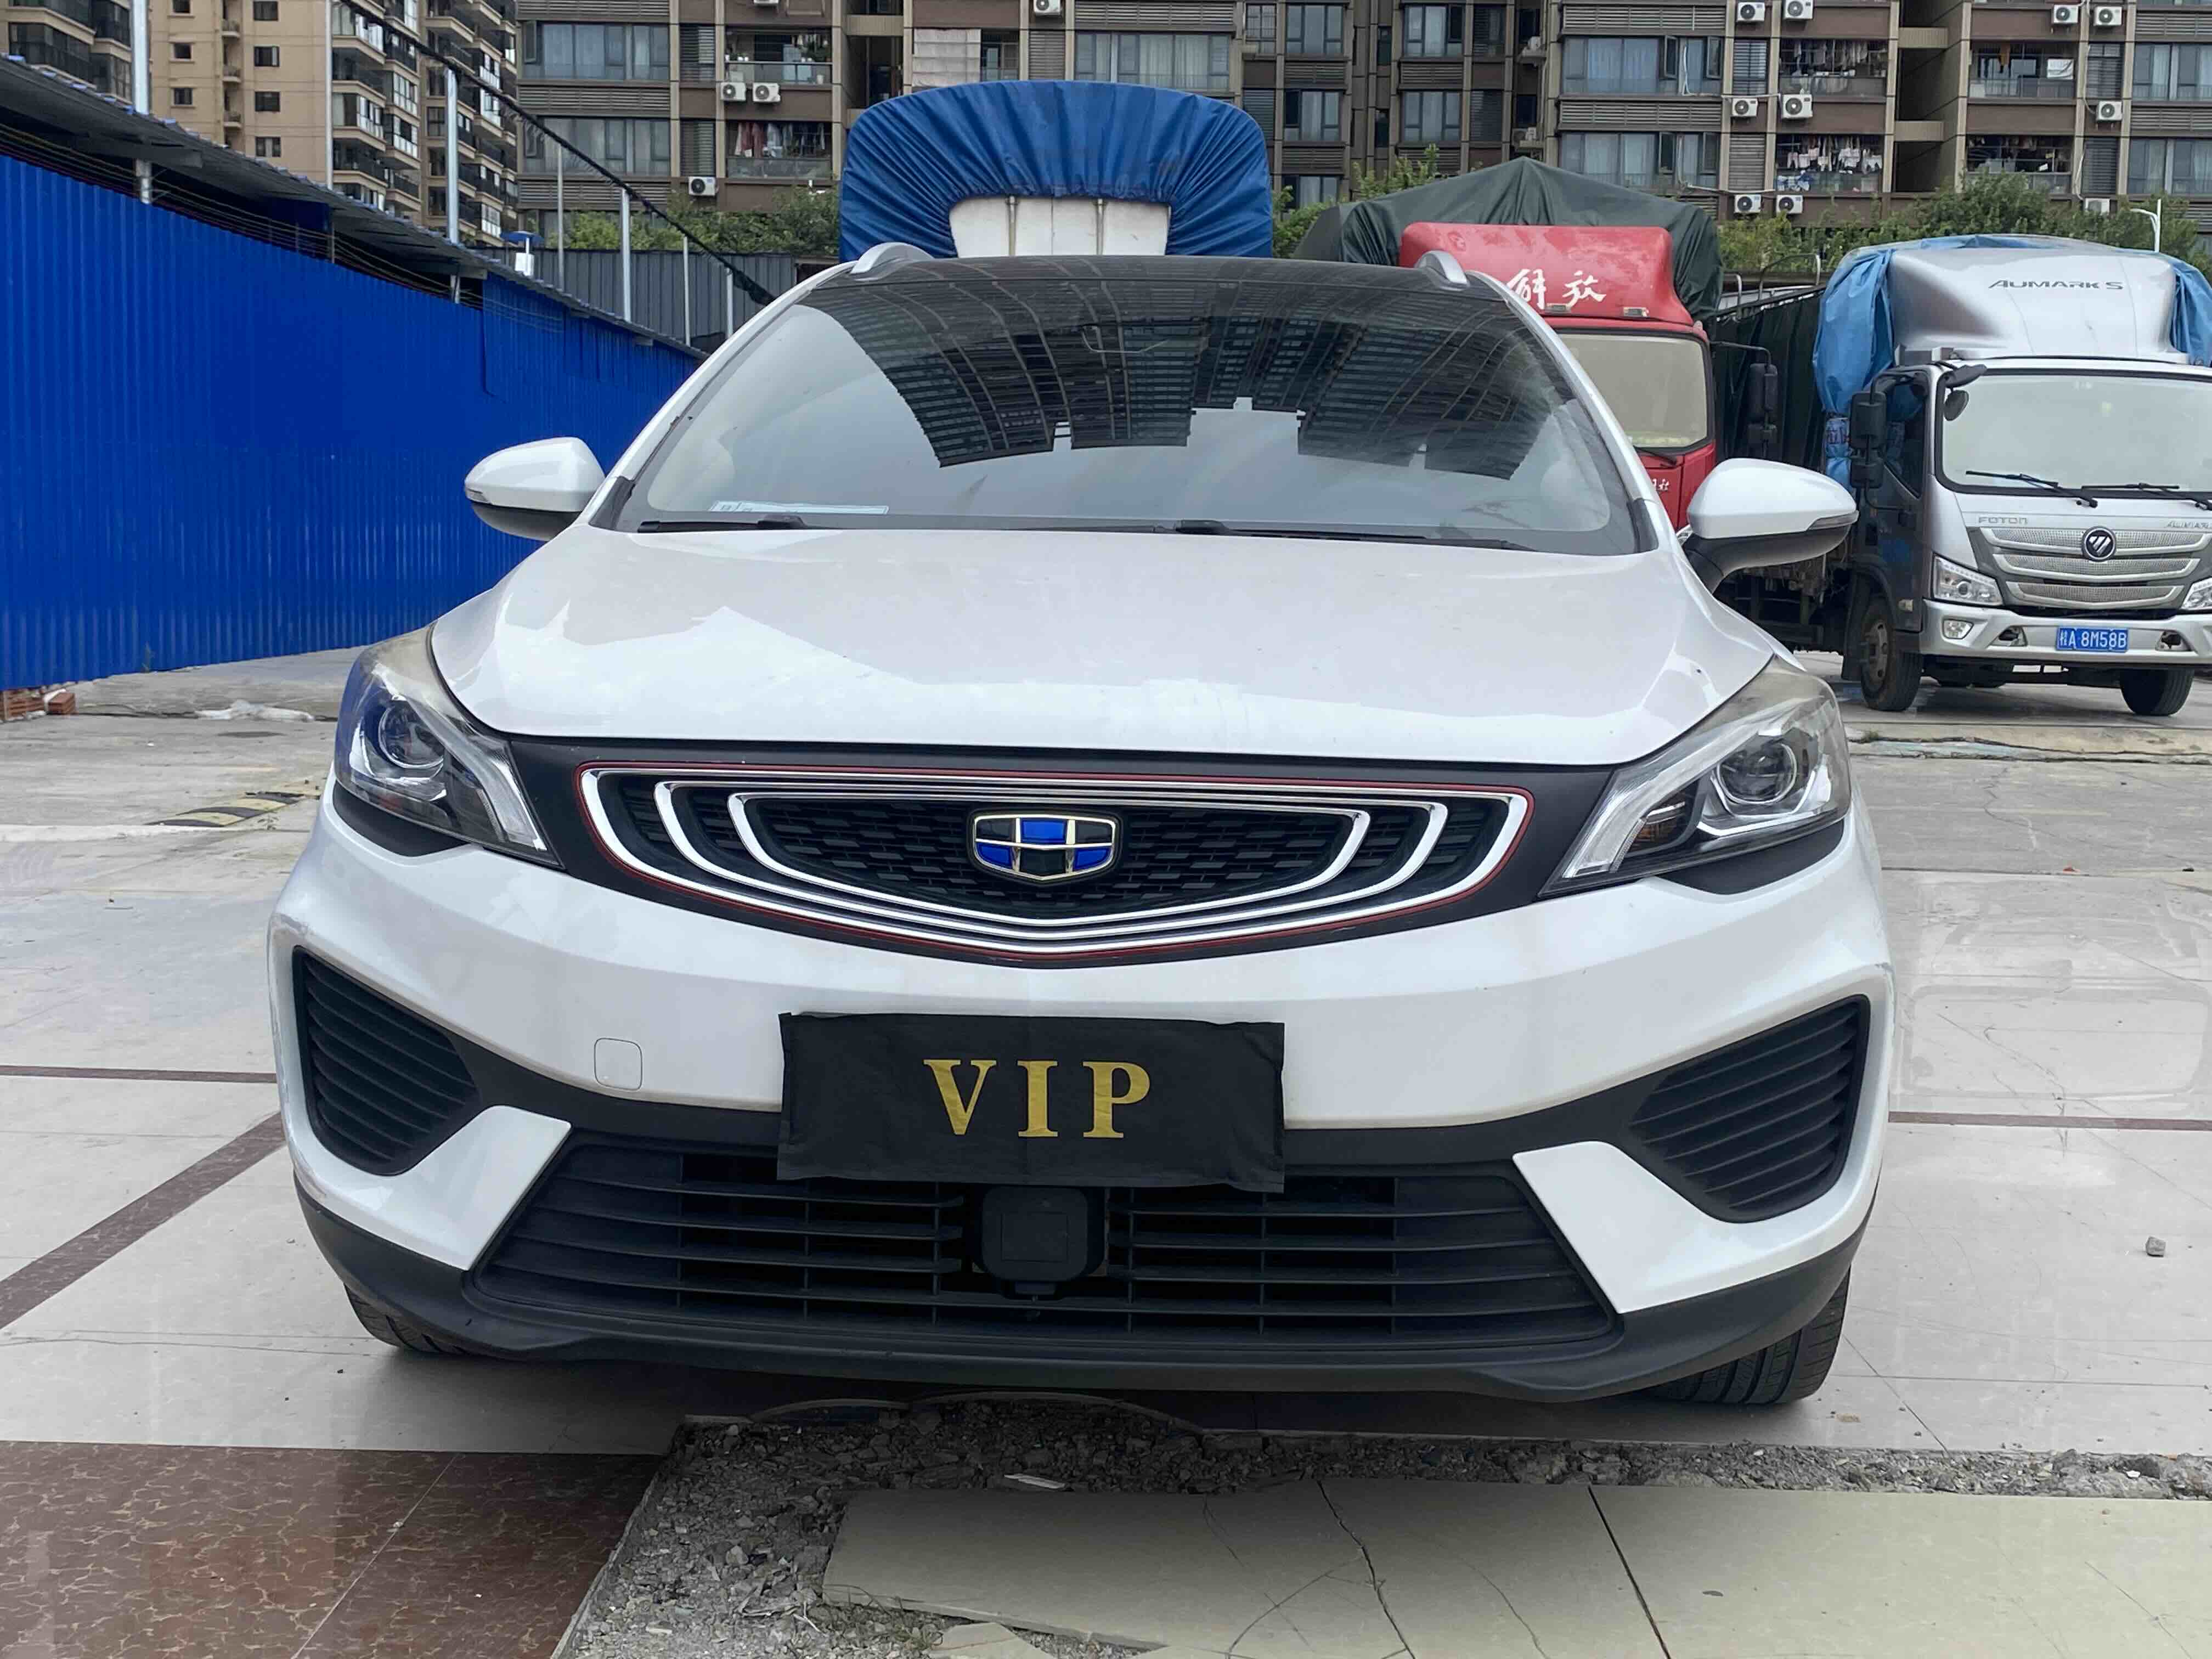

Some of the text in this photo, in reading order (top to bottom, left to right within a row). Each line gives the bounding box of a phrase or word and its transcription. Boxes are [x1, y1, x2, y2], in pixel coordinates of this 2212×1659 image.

[1988, 280, 2124, 290] AUMARK S
[923, 1059, 1150, 1138] VIP
